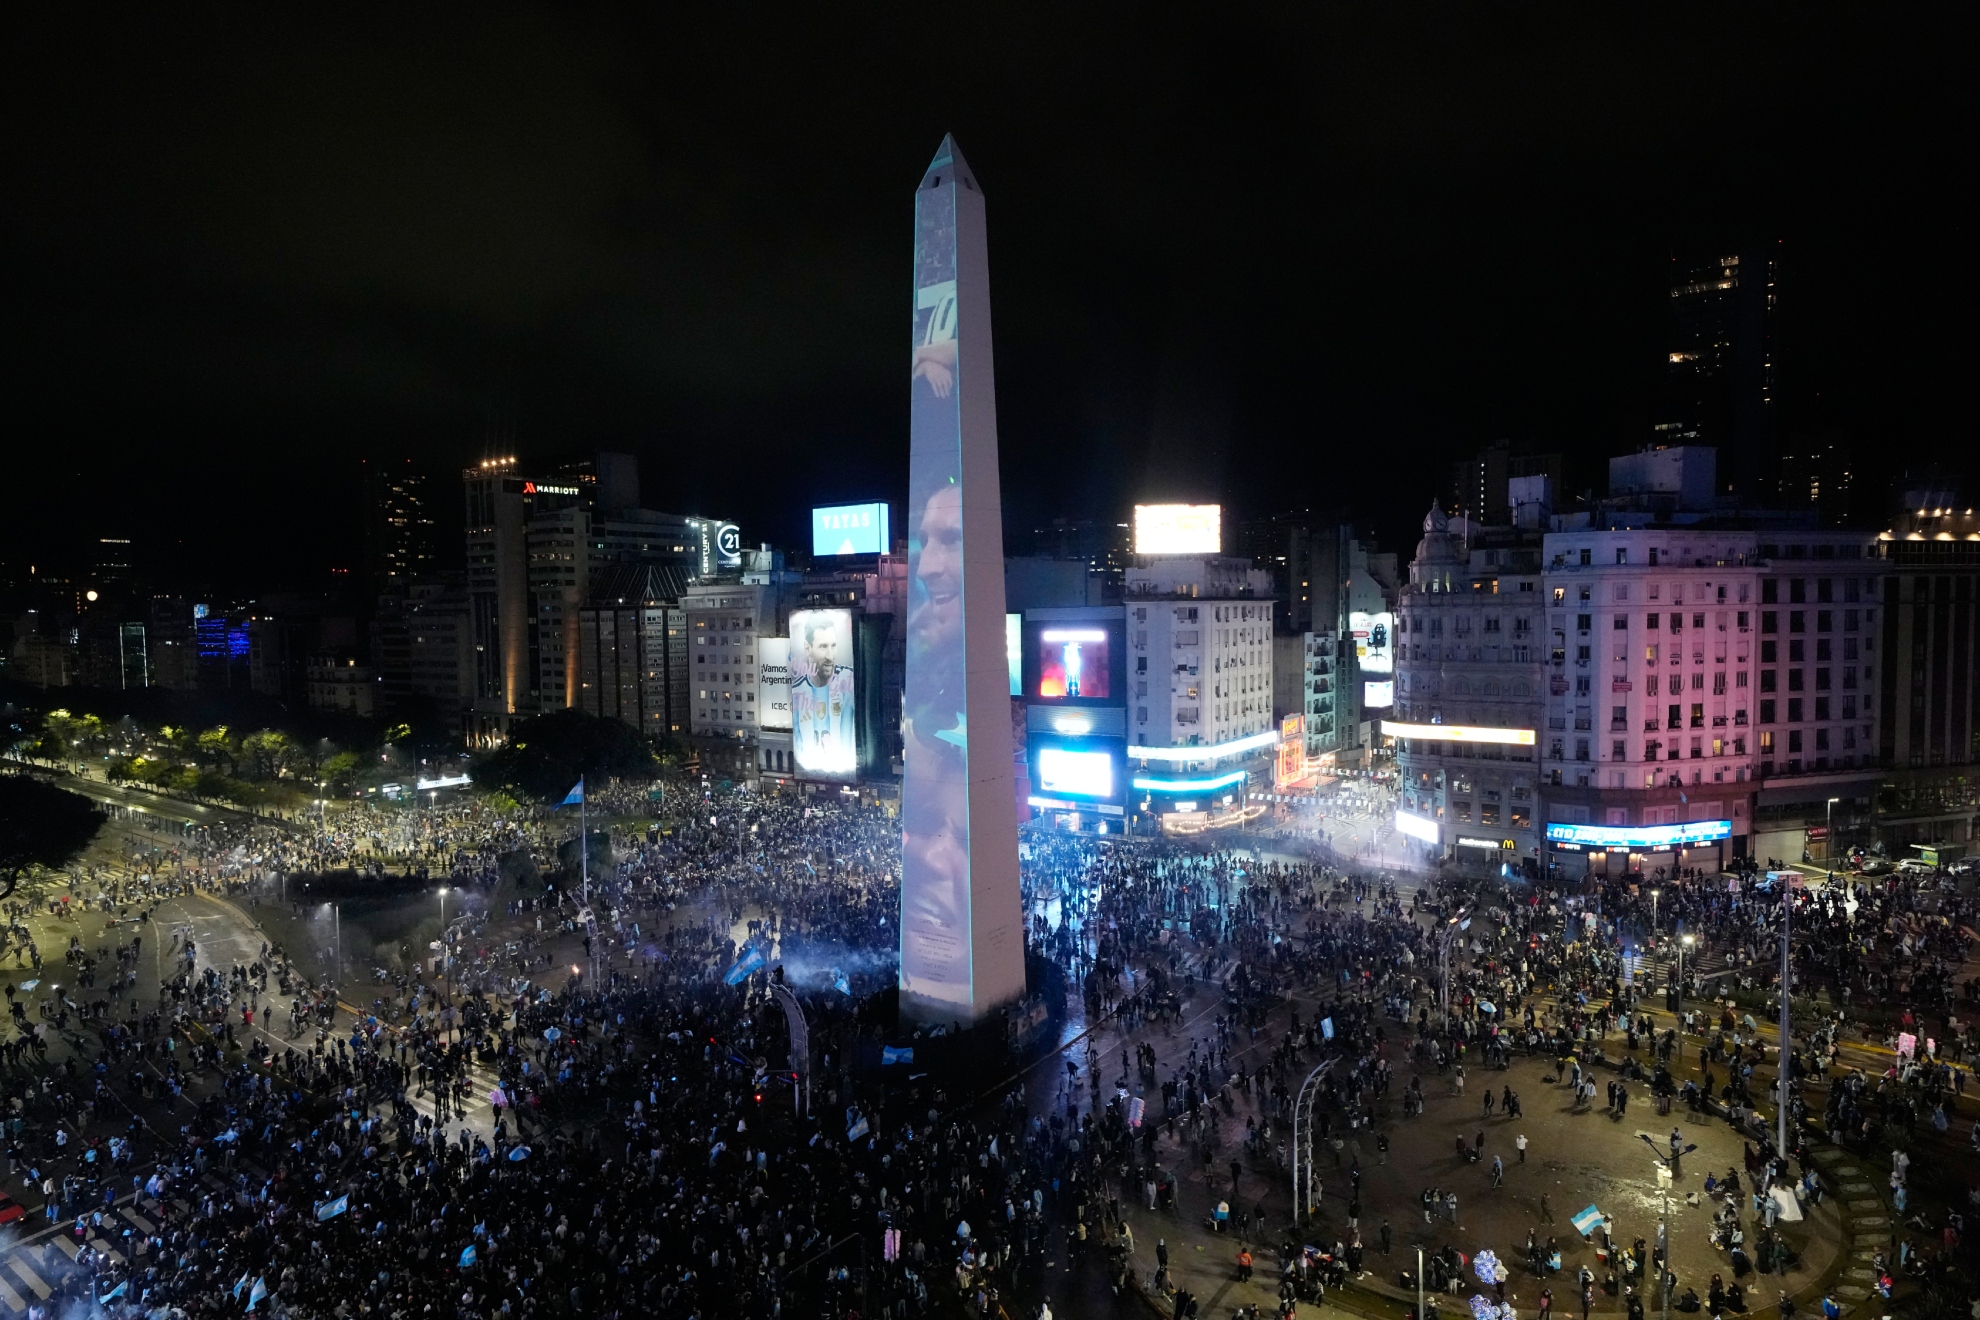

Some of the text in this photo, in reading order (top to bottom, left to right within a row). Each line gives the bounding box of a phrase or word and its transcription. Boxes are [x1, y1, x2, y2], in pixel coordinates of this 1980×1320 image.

[536, 485, 579, 496] MARRIOTT
[822, 512, 870, 530] VAYAS
[702, 523, 708, 532] 21
[724, 534, 740, 549] 21
[761, 663, 788, 675] ¡Vamos
[791, 659, 819, 678] You
[761, 675, 792, 686] Argentin
[771, 702, 788, 711] ICBC
